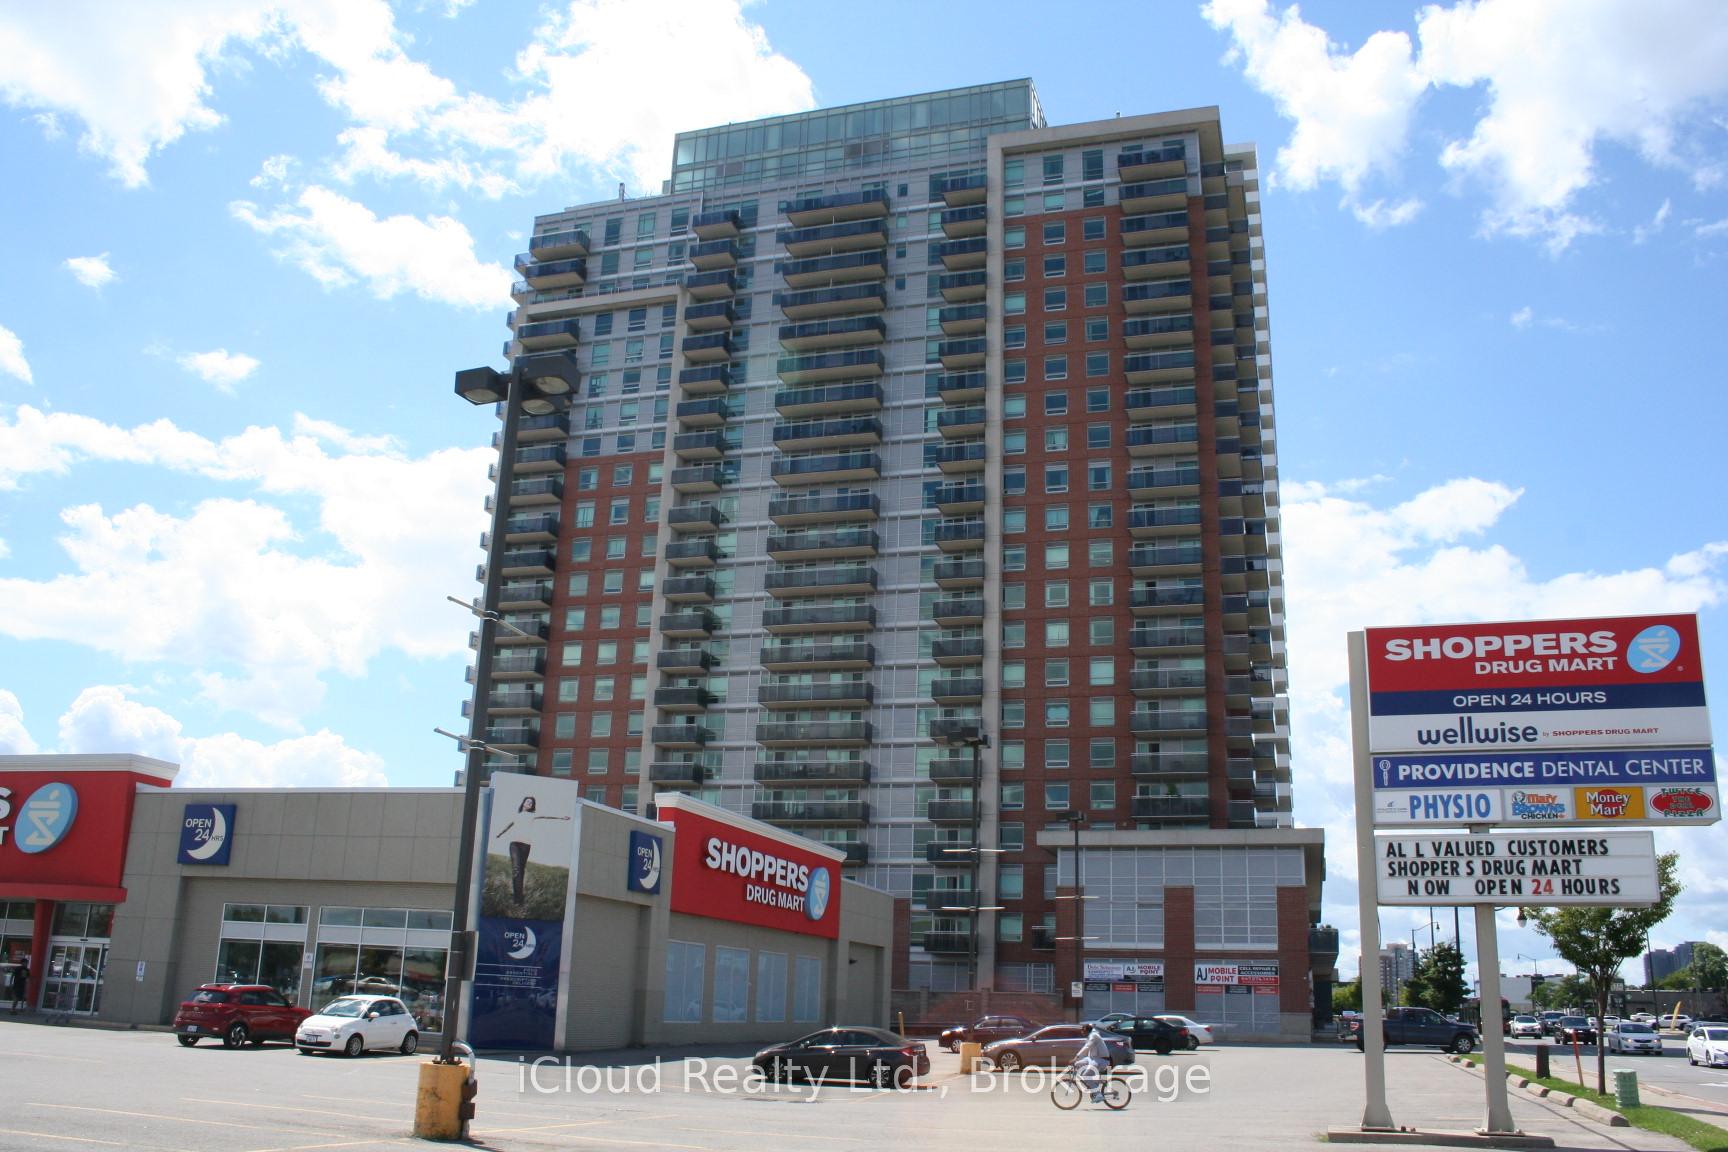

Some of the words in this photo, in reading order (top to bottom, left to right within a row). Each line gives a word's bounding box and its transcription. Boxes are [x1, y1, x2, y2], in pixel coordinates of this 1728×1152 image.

[1385, 631, 1617, 661] SHOPPERS
[1475, 659, 1542, 675] DRUG
[1549, 657, 1617, 673] MART
[1453, 694, 1506, 707] OPEN
[1510, 693, 1532, 706] 24
[1537, 691, 1607, 705] HOURS
[1417, 716, 1538, 745] wellwise
[1552, 729, 1603, 737] SHOPPERS
[1398, 761, 1535, 780] PROVIDENCE
[1542, 760, 1619, 777] DENTAL
[1625, 758, 1706, 775] CENTER
[1409, 793, 1491, 819] PHYSIO
[1586, 791, 1631, 807] Money
[1590, 803, 1625, 816] Mart
[185, 818, 212, 828] OPEN
[194, 828, 210, 841] 24
[637, 846, 653, 858] OPEN
[1432, 840, 1495, 857] VALUED
[1507, 839, 1609, 856] CUSTOMERS
[705, 837, 809, 892] SHOPPERS
[1481, 859, 1525, 876] DRUG
[1532, 858, 1582, 876] MART
[1475, 879, 1522, 895] OPEN
[1531, 878, 1554, 895] 24
[1561, 878, 1620, 895] HOURS
[746, 884, 776, 908] DRUG
[777, 891, 806, 912] MART
[504, 931, 525, 939] OPEN
[512, 939, 524, 948] 24
[1196, 967, 1208, 981] AJ
[1211, 975, 1234, 983] POINT
